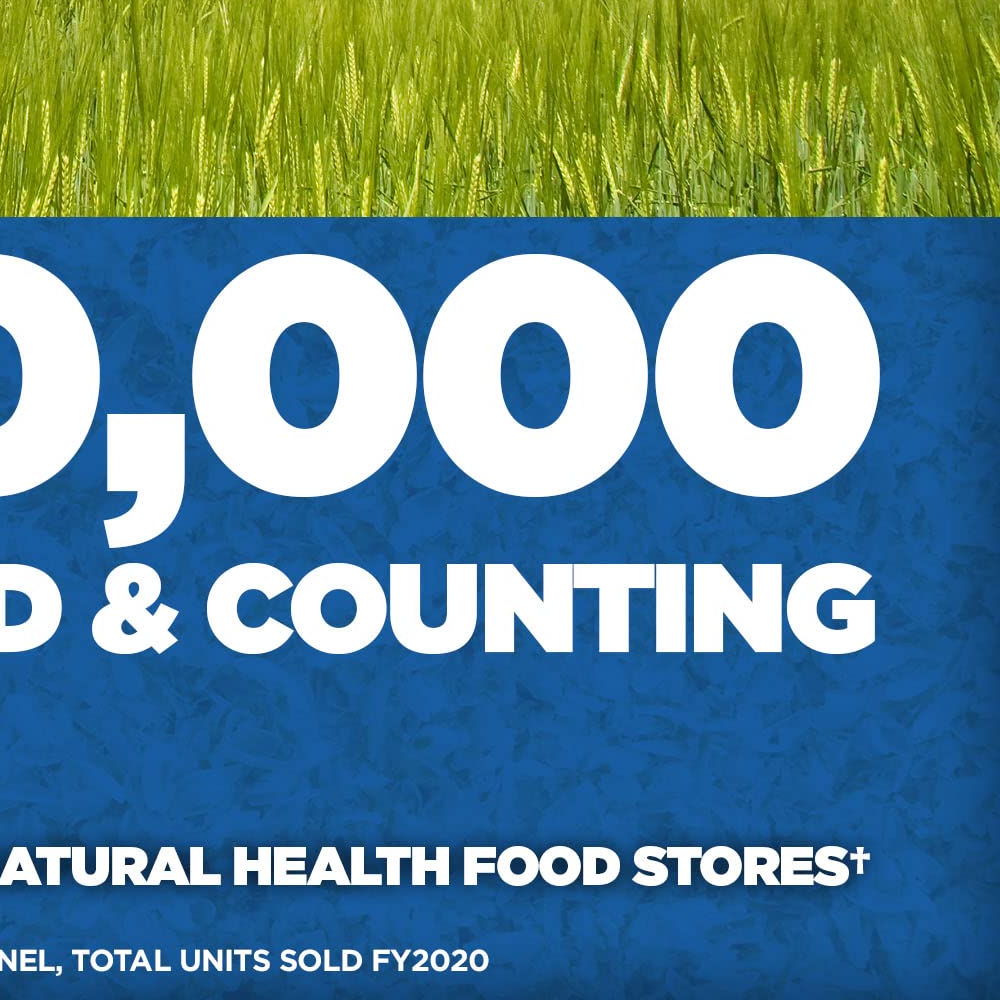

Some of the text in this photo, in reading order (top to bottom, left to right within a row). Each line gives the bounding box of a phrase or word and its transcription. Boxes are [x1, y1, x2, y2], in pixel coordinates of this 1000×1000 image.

[91, 562, 179, 655] &
[206, 562, 876, 655] COUNTING
[233, 846, 450, 886] HEALTH
[463, 845, 621, 887] FOOD
[71, 949, 172, 972] TOTAL
[180, 949, 271, 972] UNITS
[279, 949, 363, 972] SOLD
[373, 949, 489, 972] FY2020
